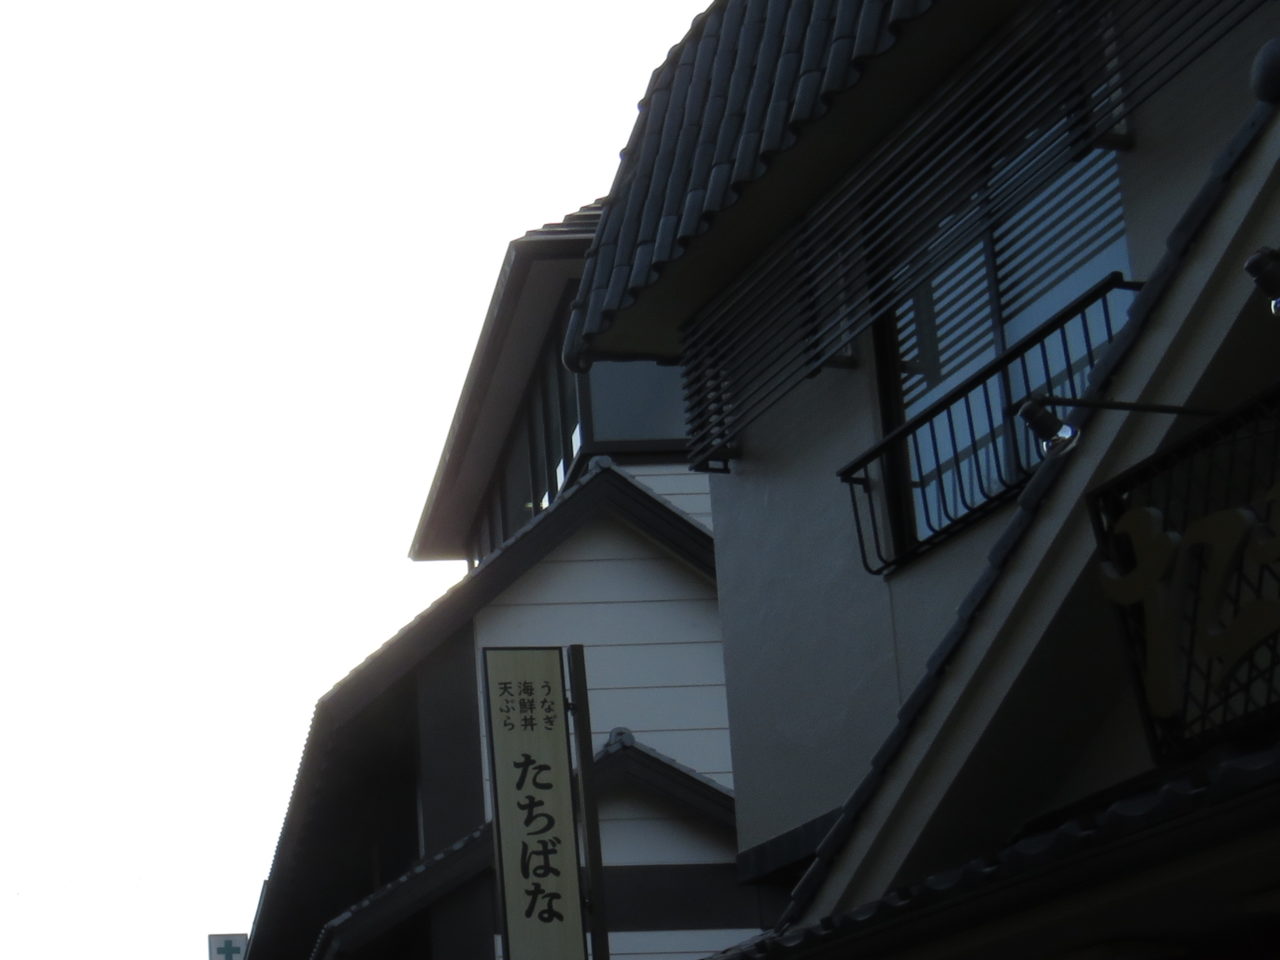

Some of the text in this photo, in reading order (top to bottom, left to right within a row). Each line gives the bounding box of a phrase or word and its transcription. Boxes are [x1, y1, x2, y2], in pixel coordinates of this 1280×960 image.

[517, 680, 538, 732] 海鮮丼
[539, 680, 558, 732] うなぎ
[512, 753, 564, 924] たちばな
